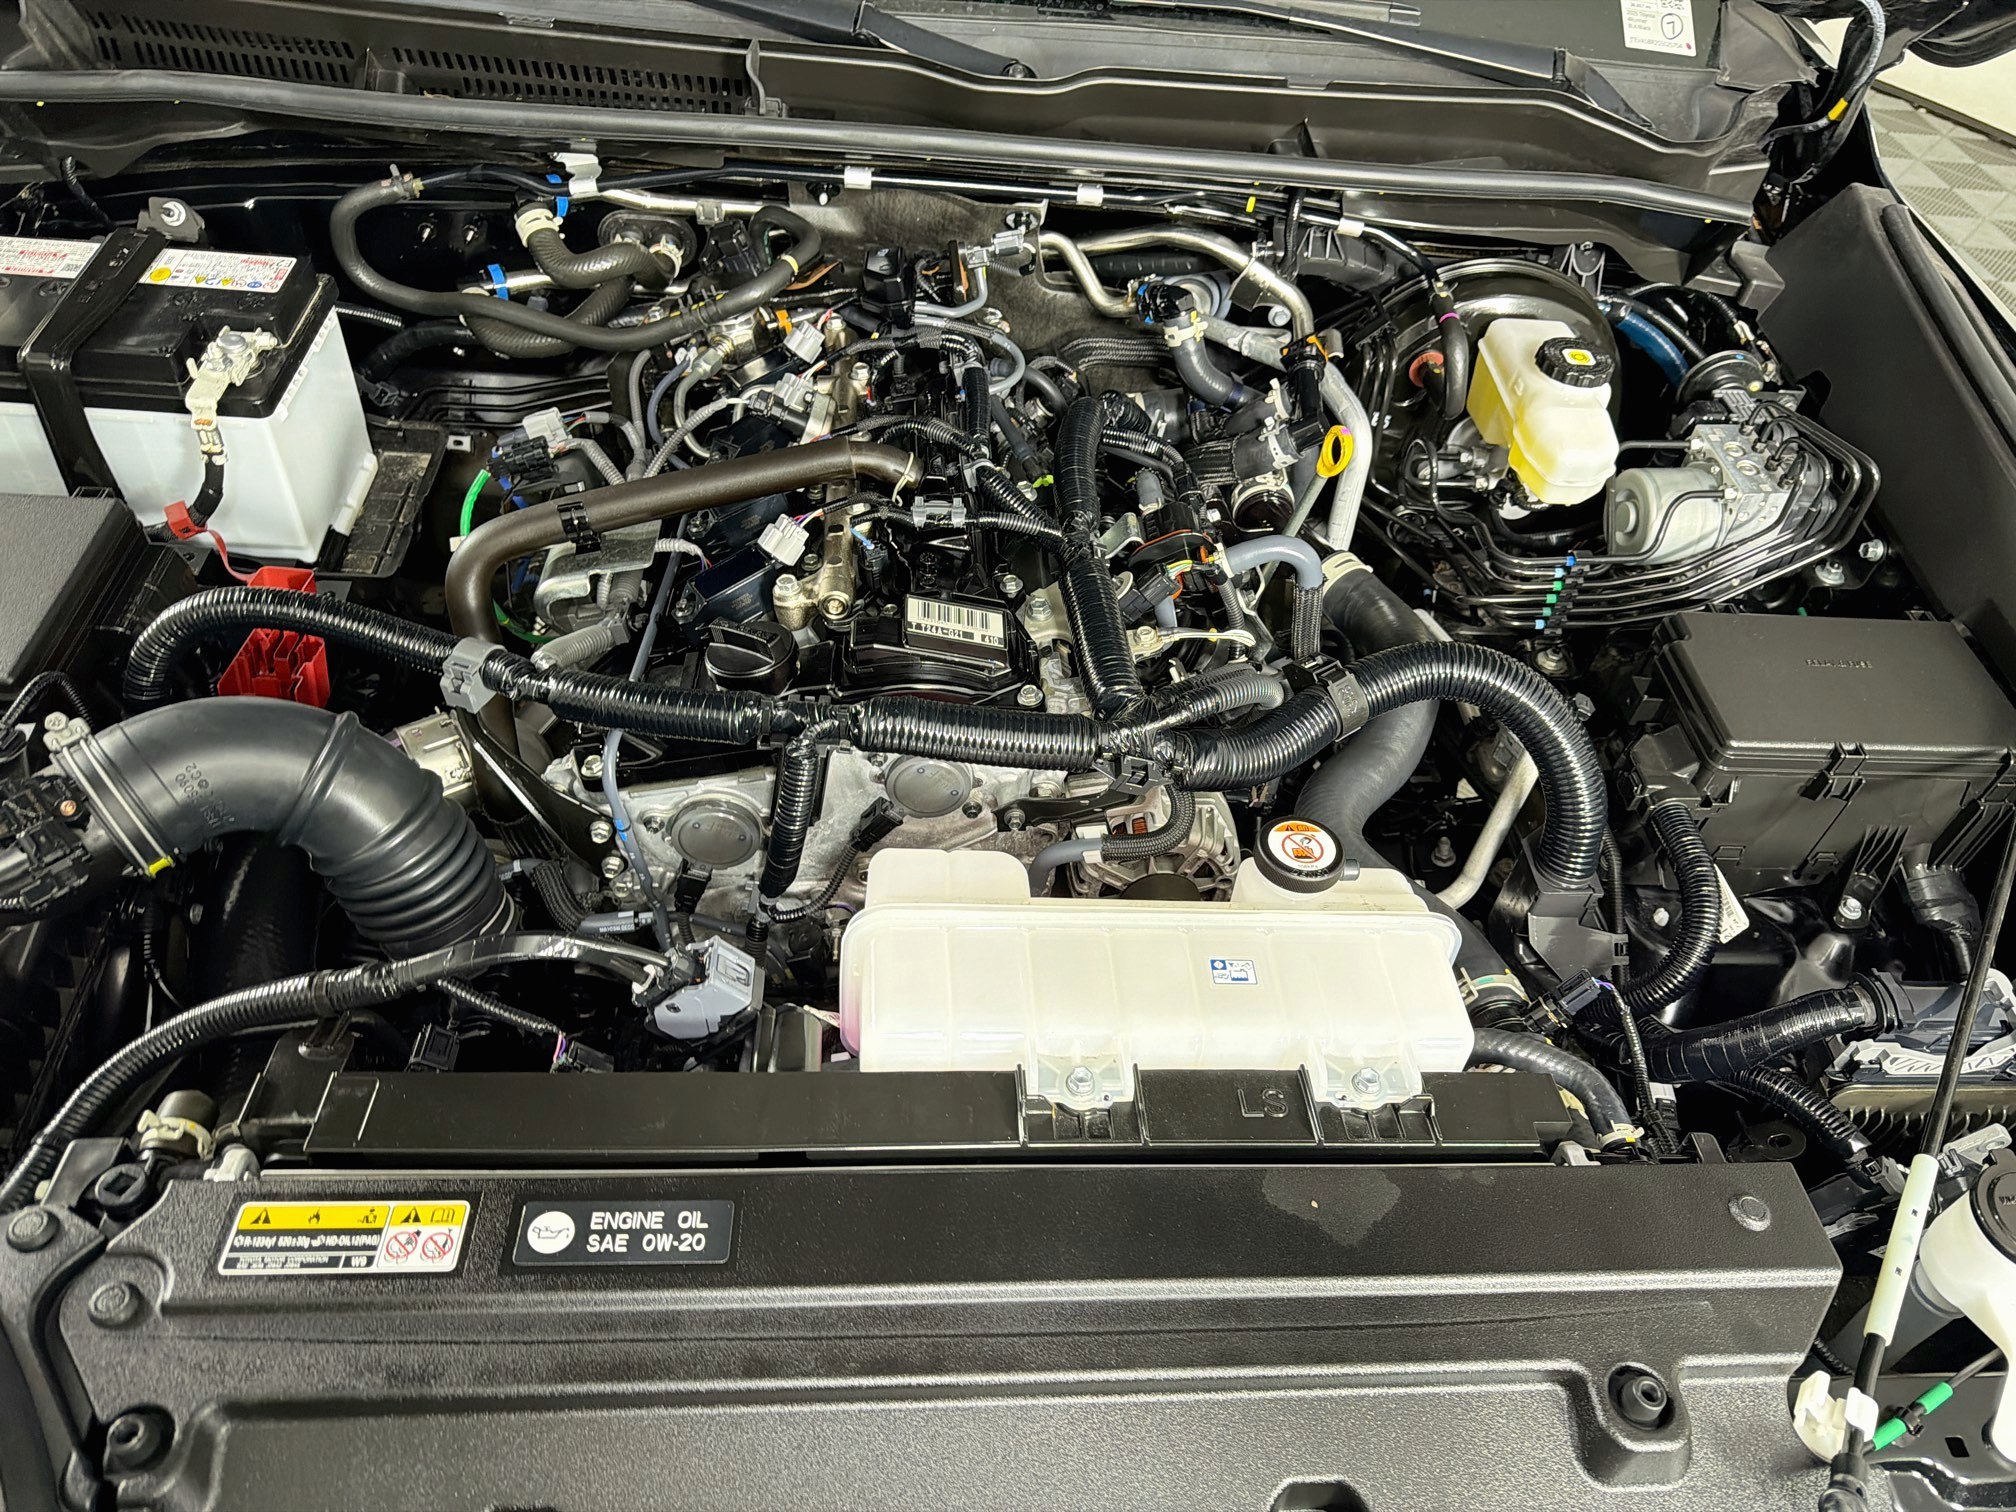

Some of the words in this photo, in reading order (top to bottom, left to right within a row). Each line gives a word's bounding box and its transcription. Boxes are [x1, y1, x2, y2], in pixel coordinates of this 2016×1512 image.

[921, 624, 962, 639] T24A-G21
[984, 635, 999, 645] 410
[1237, 1088, 1289, 1118] LS
[590, 1210, 665, 1230] ENGINE
[677, 1210, 709, 1229] OIL
[586, 1233, 630, 1253] SAE
[642, 1233, 706, 1252] 0W-20
